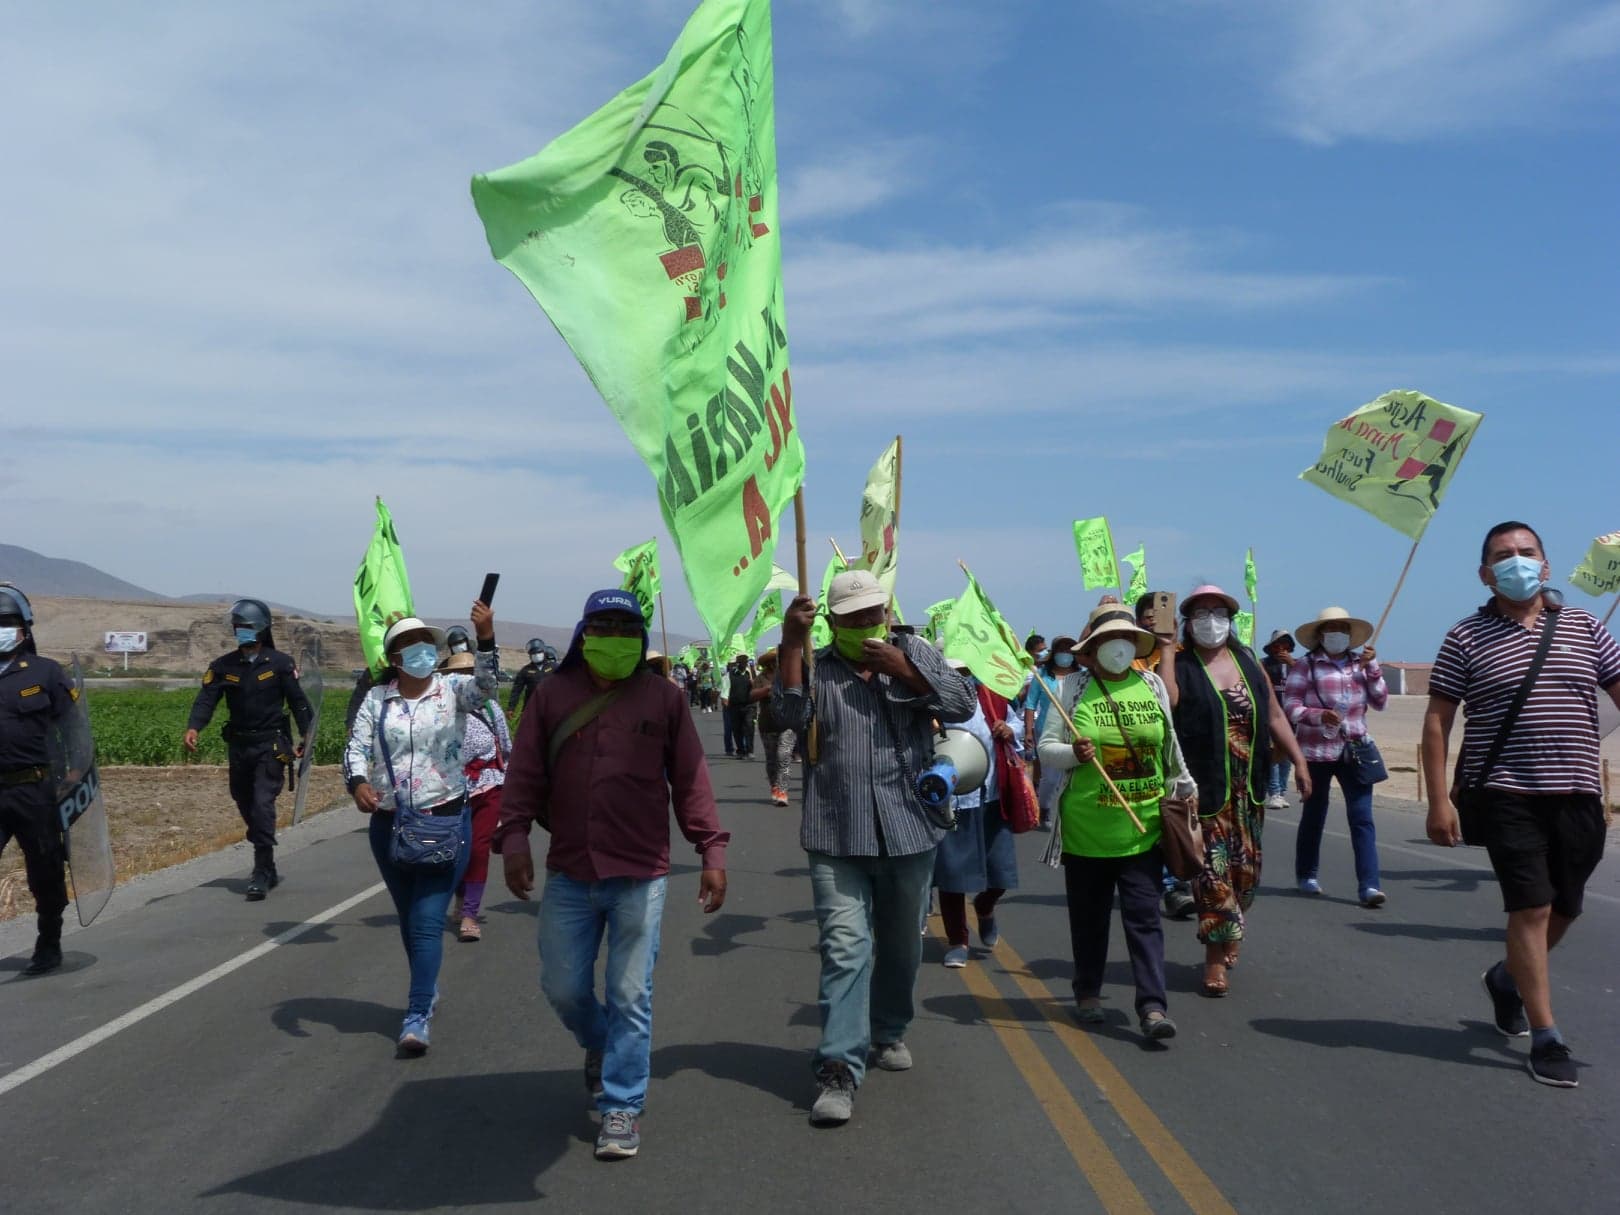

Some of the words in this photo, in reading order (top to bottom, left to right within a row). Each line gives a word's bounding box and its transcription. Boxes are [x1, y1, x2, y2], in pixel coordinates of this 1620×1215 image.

[598, 596, 632, 608] YURA
[1093, 700, 1126, 714] TODS
[1094, 715, 1119, 727] VALL
[1122, 714, 1136, 726] DE
[59, 772, 98, 831] POL
